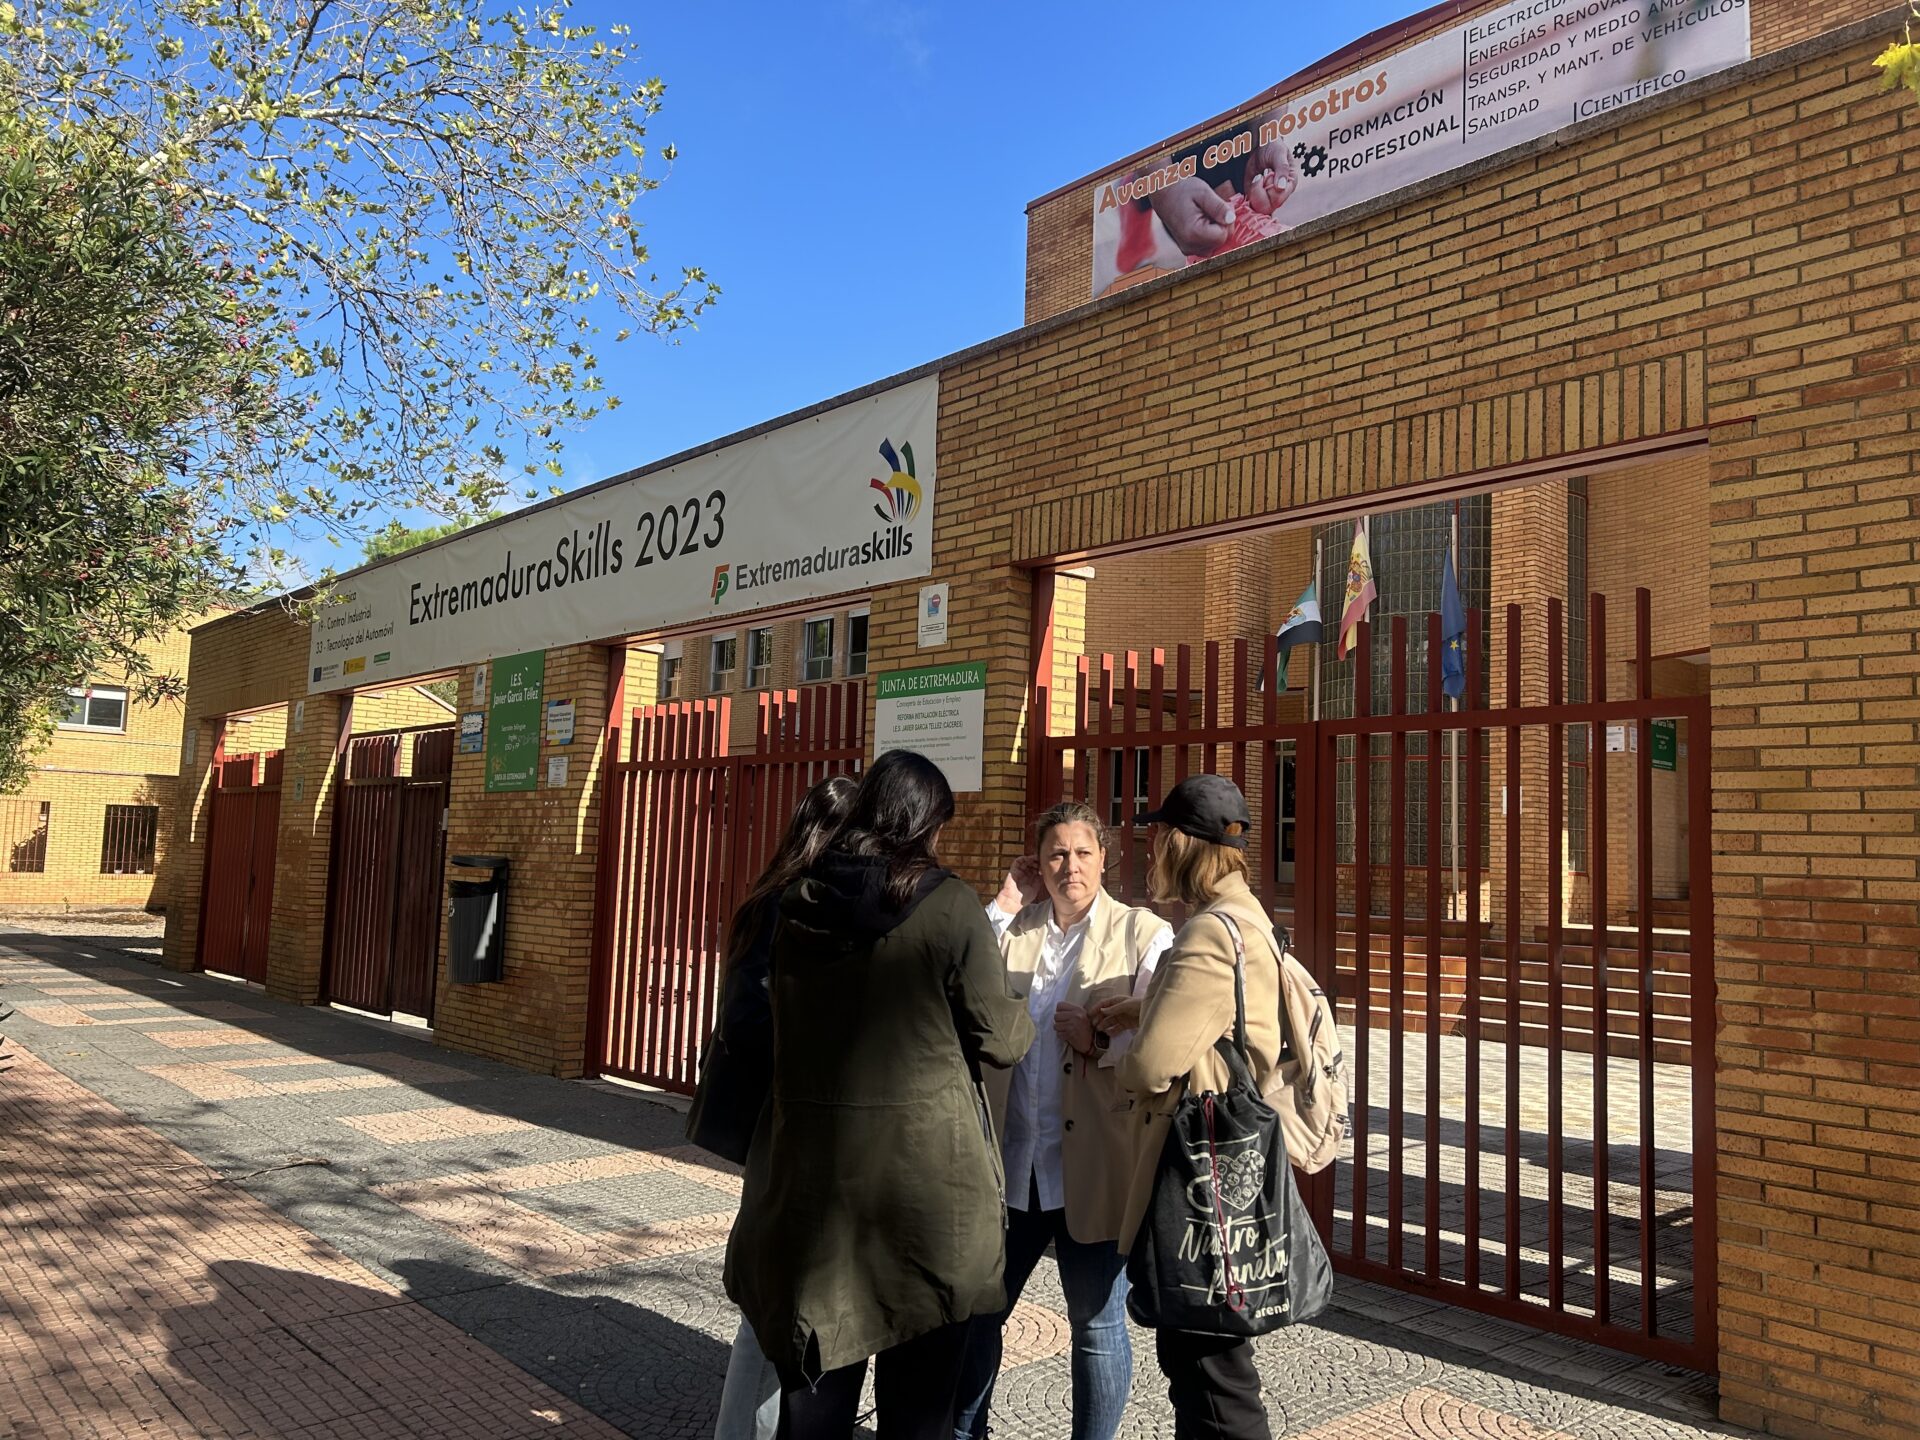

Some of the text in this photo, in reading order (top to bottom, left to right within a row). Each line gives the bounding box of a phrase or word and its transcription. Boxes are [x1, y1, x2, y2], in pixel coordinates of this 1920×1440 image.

[1468, 43, 1560, 89] SEGURIDAD
[1568, 34, 1577, 48] Y
[1584, 10, 1640, 41] MEDIO
[1469, 0, 1565, 43] ELECTRICID
[1469, 0, 1629, 66] ENERGÍAS RENOVA
[1467, 0, 1745, 111] TRANSP. Y MANT. DE VEHÍCULOS
[1328, 89, 1444, 149] FORMACIÓN
[1468, 98, 1539, 134] SANIDAD
[1581, 69, 1686, 117] CIENTÍFICO
[1098, 70, 1388, 214] Avanza con nosotros
[1328, 115, 1460, 178] PROFESIONAL
[409, 489, 727, 626] ExtremaduraSkills 2023
[735, 525, 913, 591] Extremaduraskills
[327, 611, 347, 630] Control
[347, 603, 372, 624] Industrial
[355, 629, 365, 644] del
[366, 620, 394, 641] Automóvil
[492, 690, 507, 708] Javier
[881, 670, 980, 695] JUNTA DE EXTREMADURA
